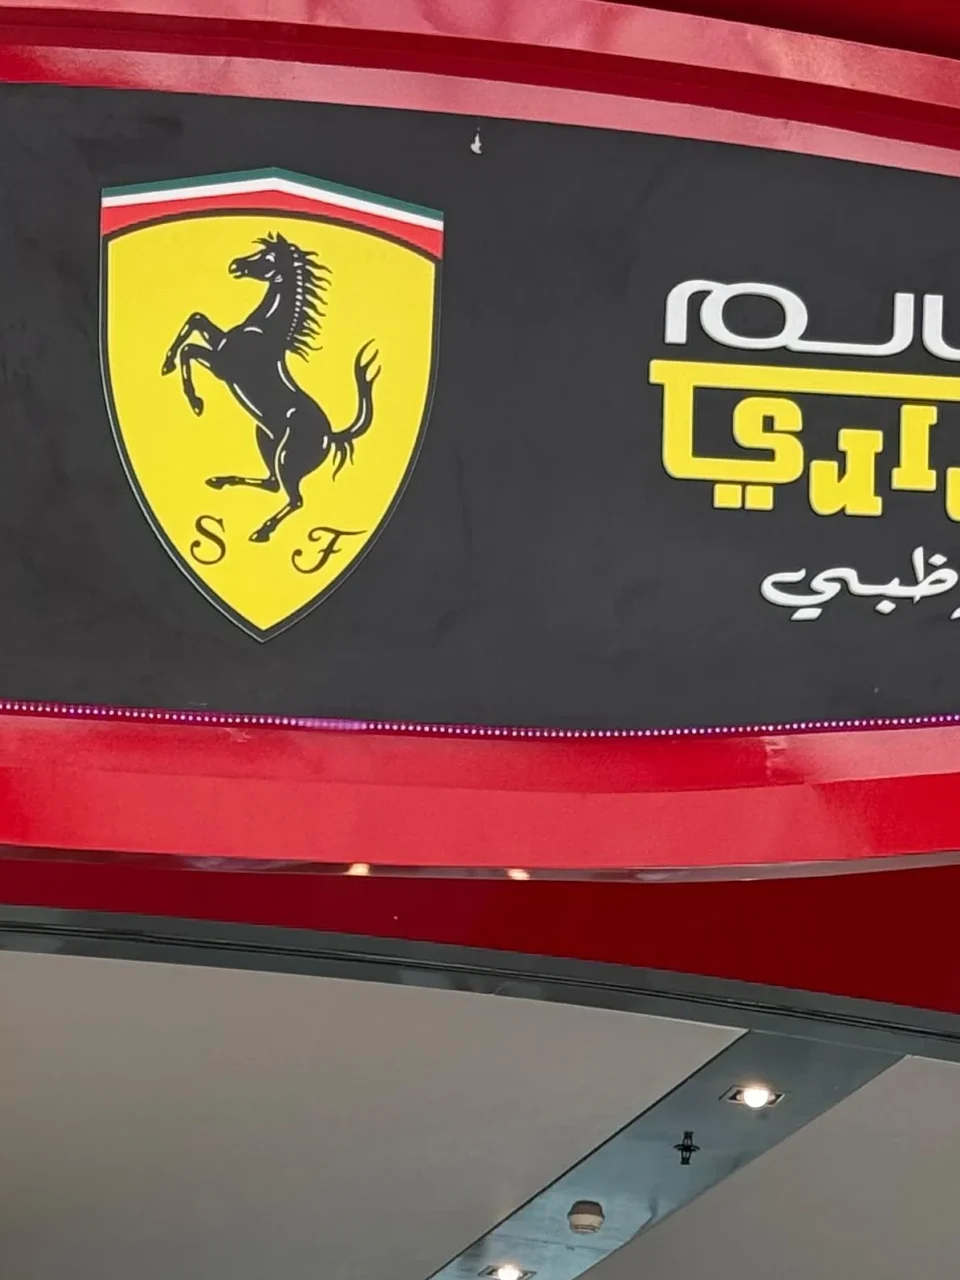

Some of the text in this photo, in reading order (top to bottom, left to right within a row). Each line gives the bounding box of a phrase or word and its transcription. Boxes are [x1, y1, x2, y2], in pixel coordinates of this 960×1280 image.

[664, 279, 960, 362] الم
[189, 514, 369, 575] S F
[760, 546, 960, 622] ظبي
